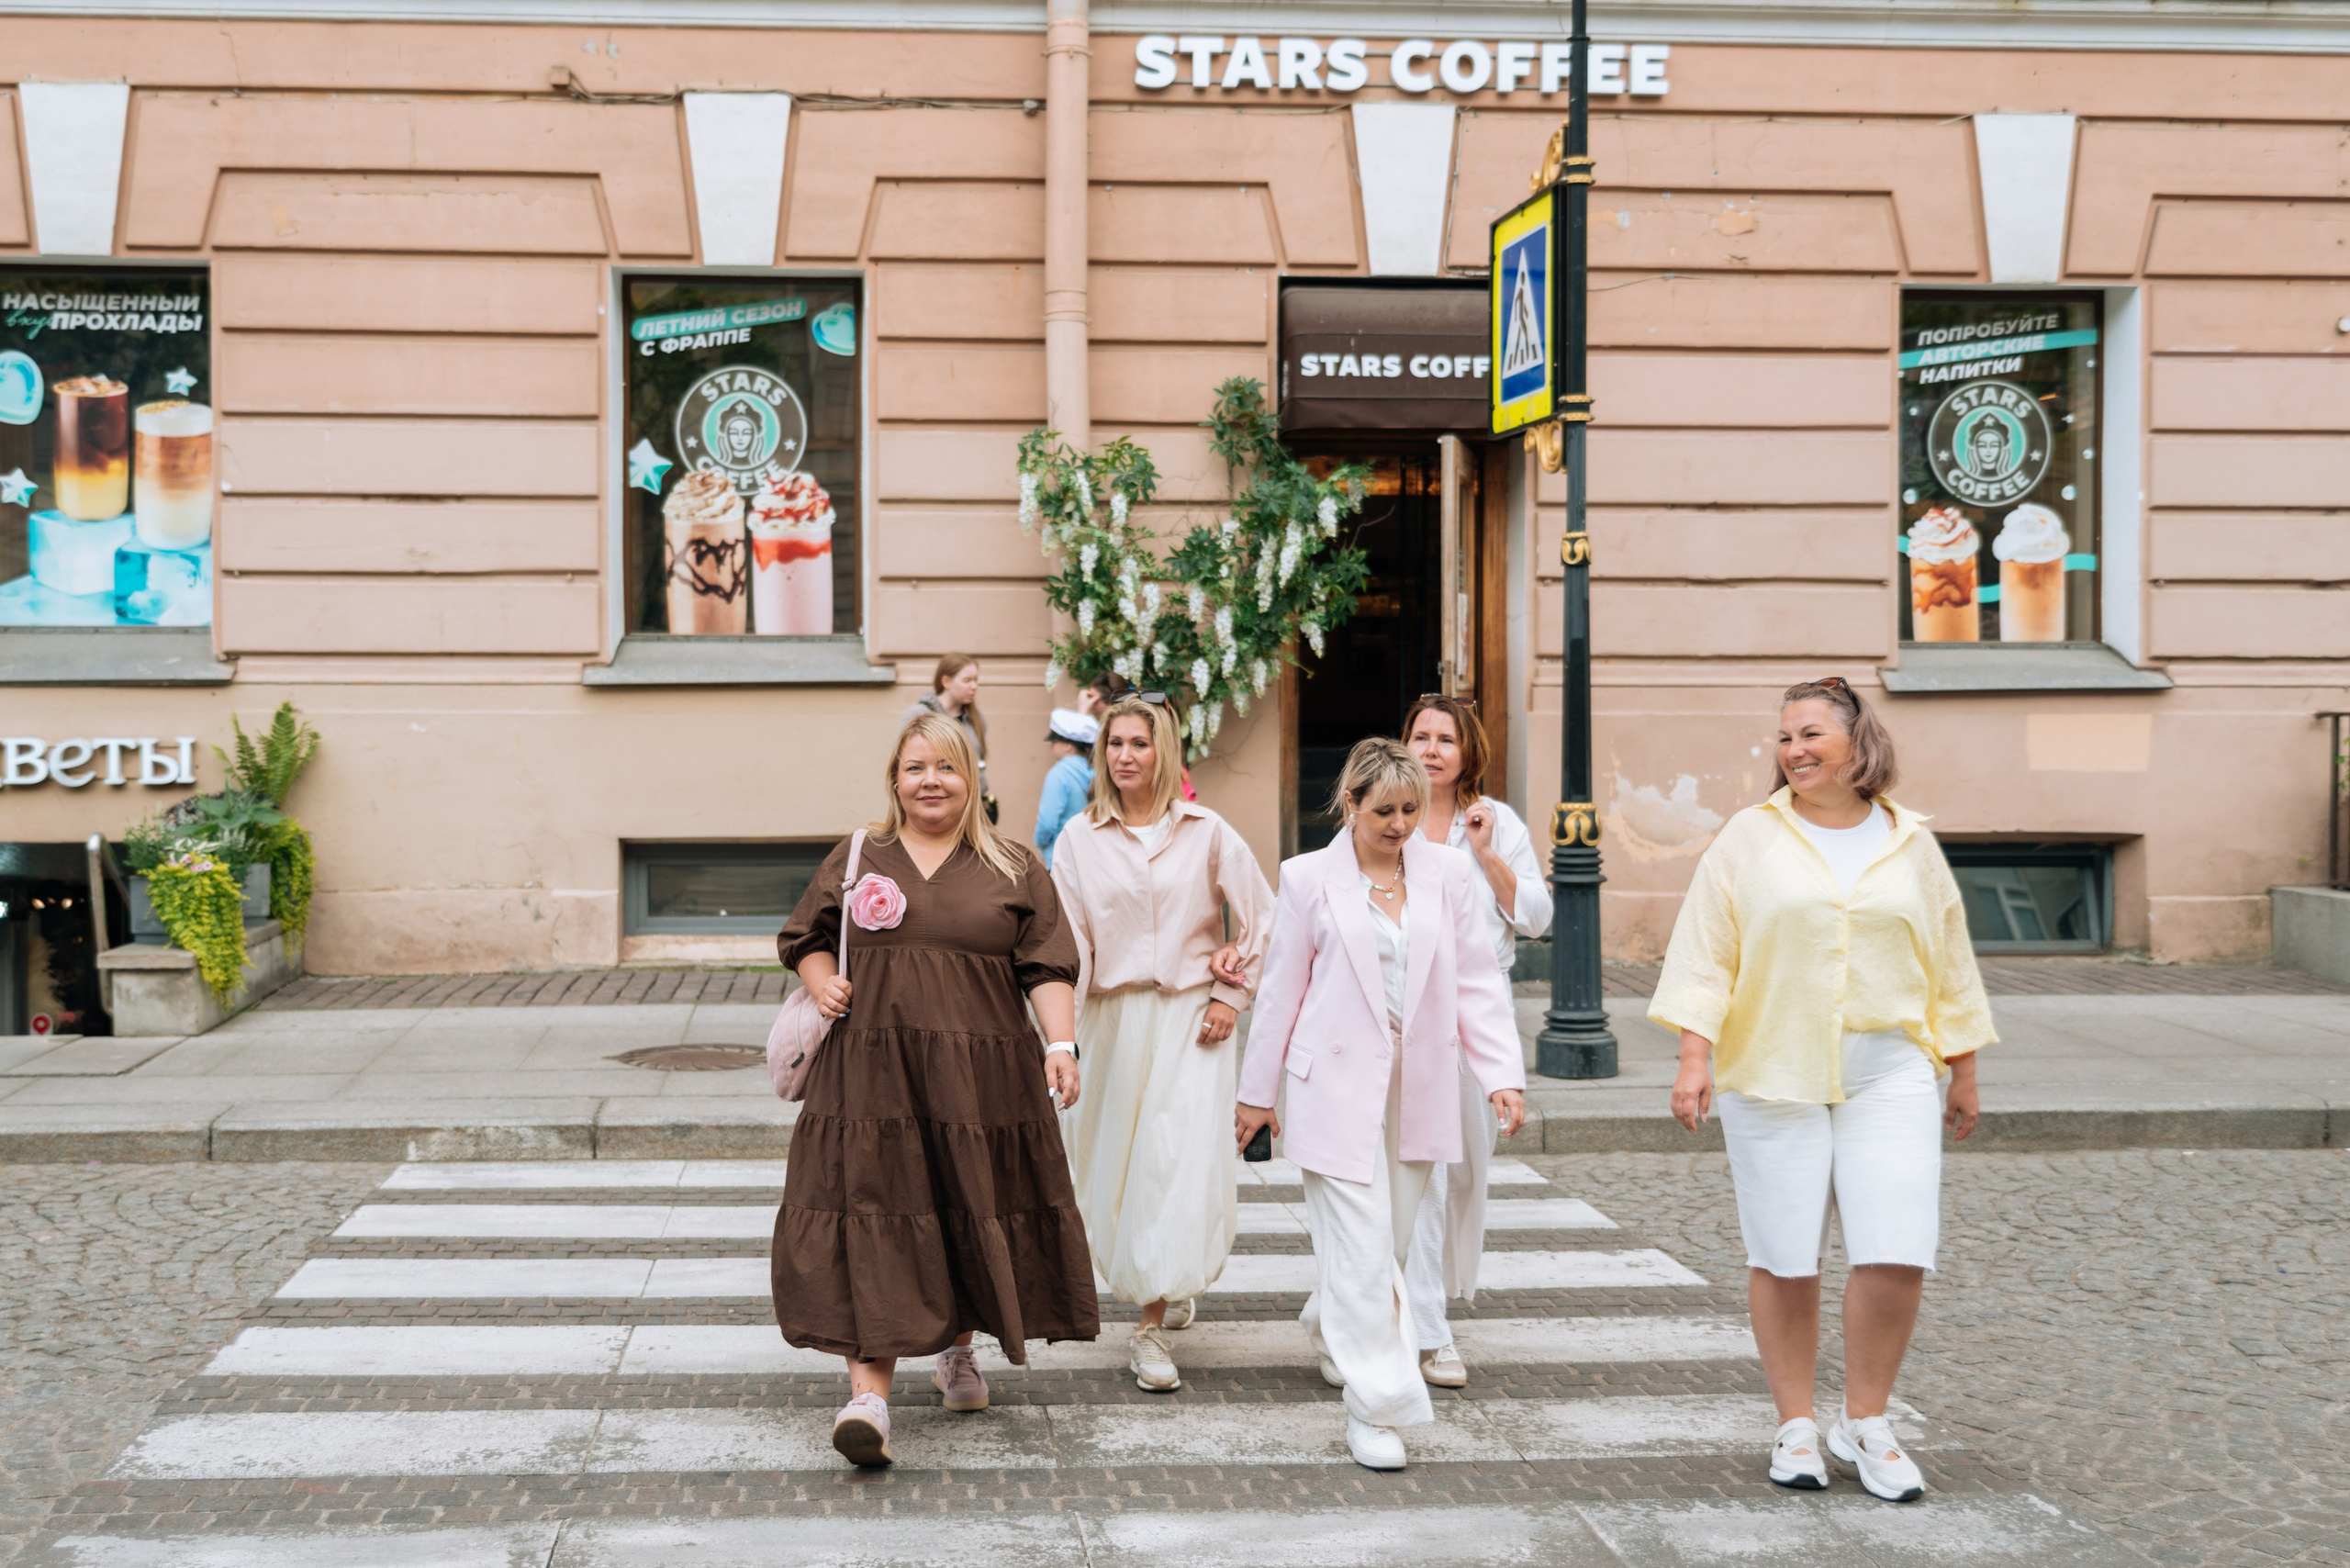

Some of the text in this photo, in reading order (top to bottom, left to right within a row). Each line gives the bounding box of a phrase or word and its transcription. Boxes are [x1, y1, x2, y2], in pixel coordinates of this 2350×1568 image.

[1135, 35, 1670, 95] STARS COFFEE
[50, 310, 203, 334] ПРОХЛАДЫ
[639, 301, 802, 338] ЛЕТНИЙ СЕЗОН
[1918, 313, 2059, 345] ПОПРОБУЙТЕ
[641, 328, 752, 356] С ФРАППЕ
[1918, 334, 2045, 366] АВТОРСКИЕ
[1300, 353, 1403, 378] STARS
[1919, 356, 2022, 385] НАПИТКИ
[700, 372, 787, 407] STARS
[1951, 386, 2032, 419] STARS
[1947, 468, 2031, 501] COFFEE
[0, 736, 196, 788] веты
